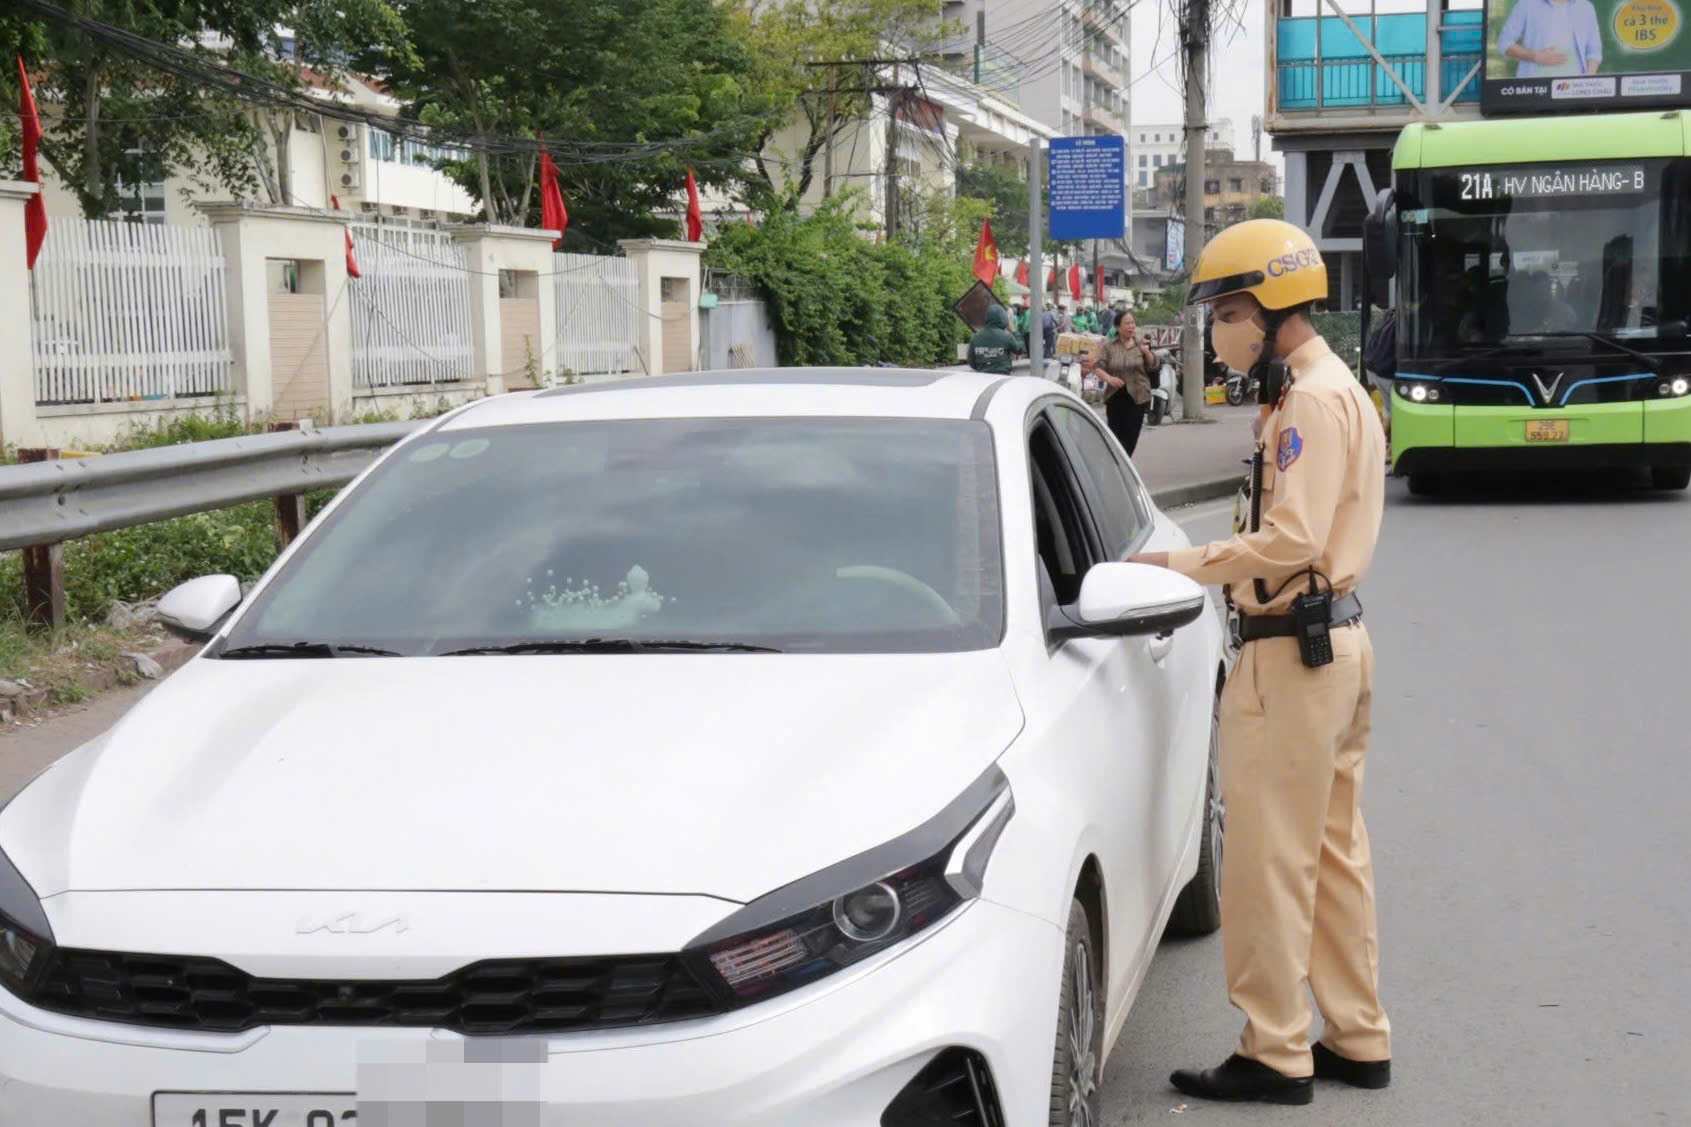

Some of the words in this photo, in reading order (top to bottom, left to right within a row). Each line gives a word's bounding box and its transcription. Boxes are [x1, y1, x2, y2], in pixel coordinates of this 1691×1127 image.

[1639, 14, 1647, 26] 3
[1635, 28, 1657, 41] IBS
[1501, 86, 1514, 95] CÓ
[1516, 85, 1533, 95] BÁN
[1461, 173, 1493, 199] 21A
[1504, 177, 1527, 195] HV
[1532, 170, 1575, 193] NGÂN
[1634, 171, 1645, 189] B
